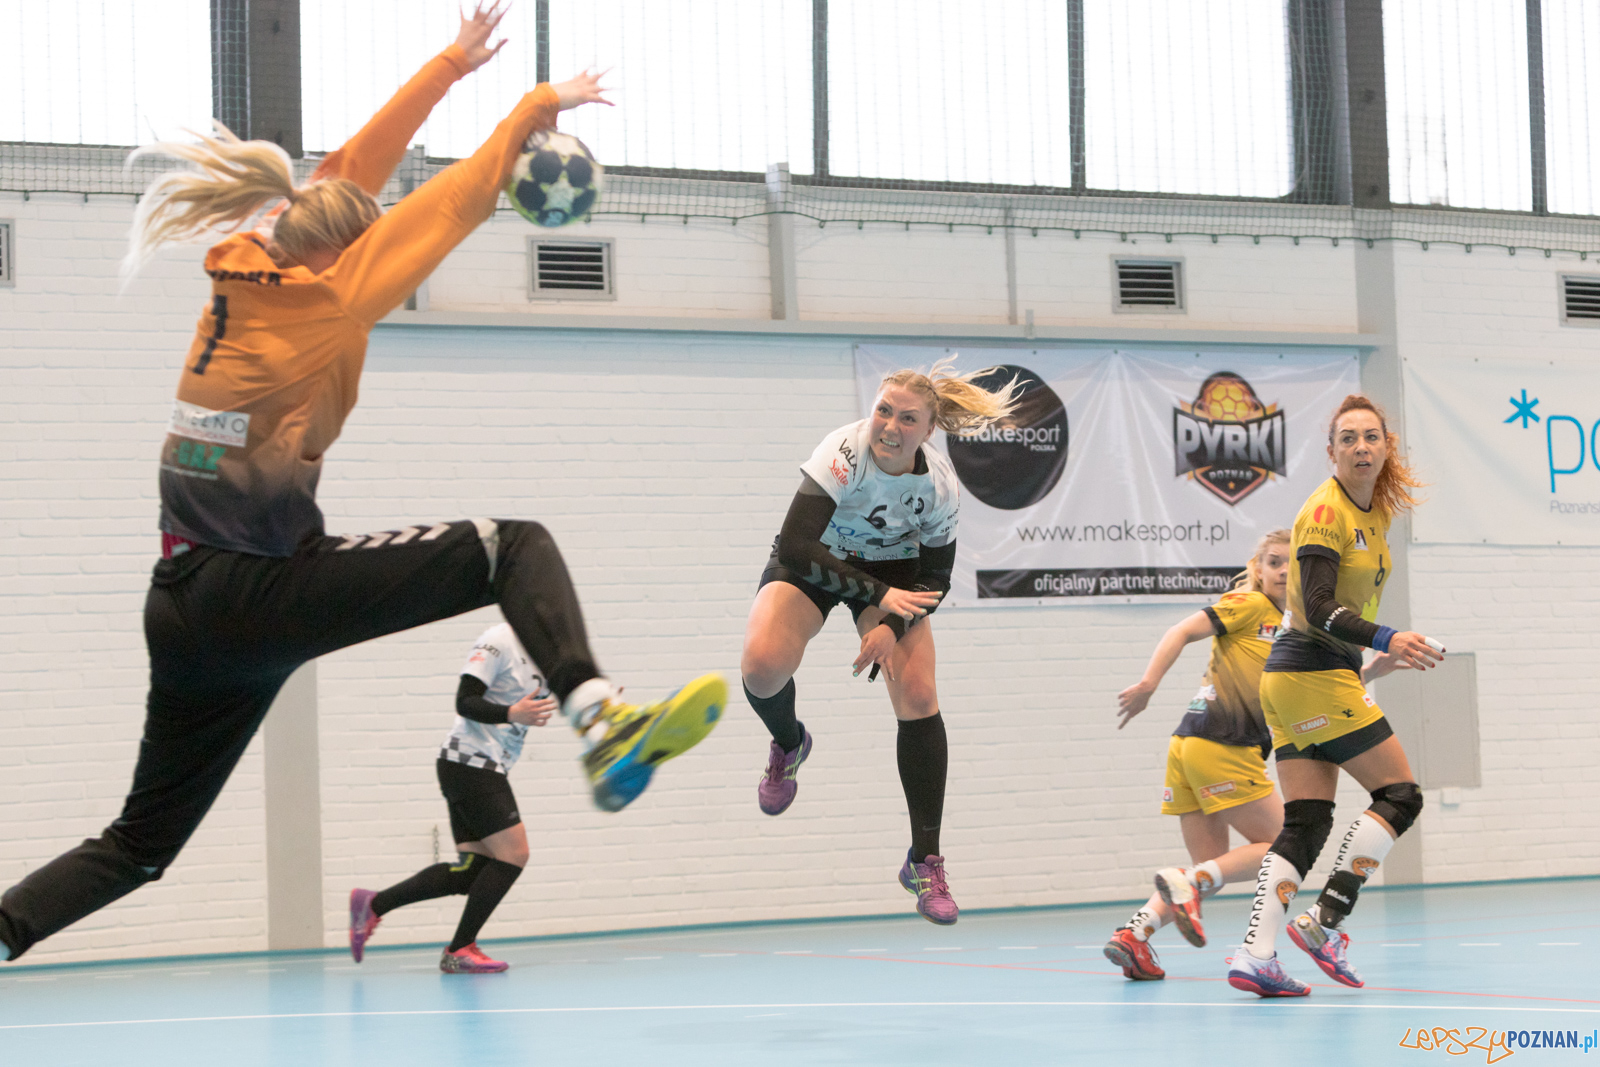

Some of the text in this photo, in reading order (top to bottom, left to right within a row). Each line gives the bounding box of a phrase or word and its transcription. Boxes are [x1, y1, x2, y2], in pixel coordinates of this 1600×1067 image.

[193, 294, 228, 375] 1
[958, 423, 1060, 446] makesport
[1177, 412, 1283, 473] PYRKI
[1030, 444, 1057, 452] POLSKA
[863, 505, 888, 529] 6
[1017, 519, 1230, 546] www.makesport.pl
[1034, 571, 1231, 594] oficjalny partner techniczny
[1374, 553, 1386, 587] 6
